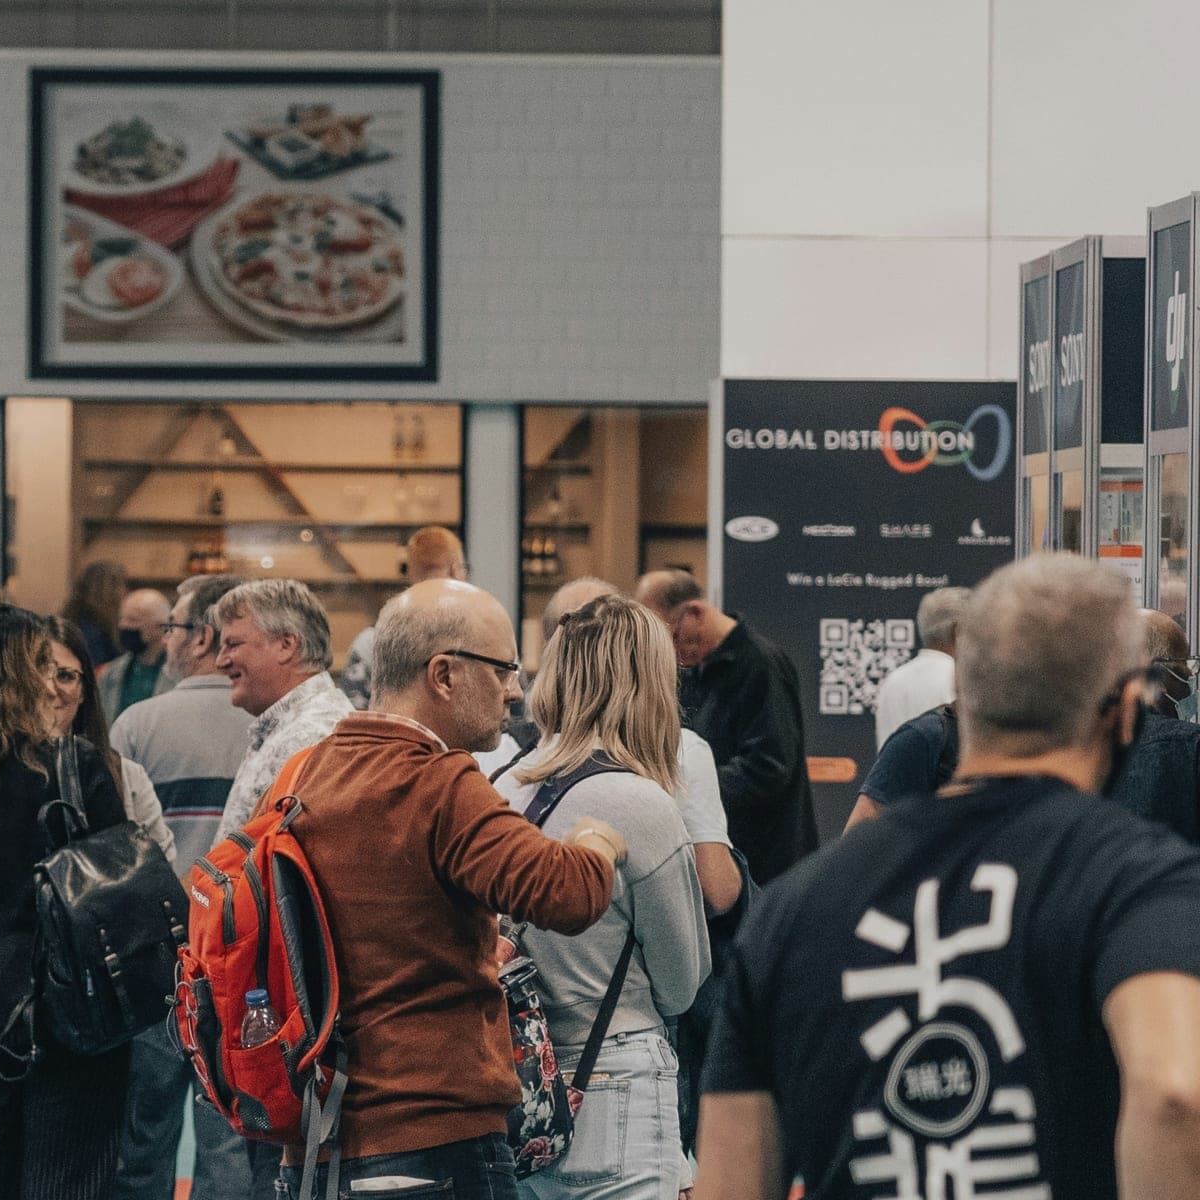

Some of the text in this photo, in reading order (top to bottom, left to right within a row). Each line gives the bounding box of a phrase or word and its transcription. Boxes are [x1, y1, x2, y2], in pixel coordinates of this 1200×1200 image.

[726, 429, 974, 451] GLOBAL DISTRIBUTION
[787, 573, 812, 586] Win
[815, 576, 825, 586] a
[827, 572, 863, 586] LaCie
[865, 572, 913, 590] Rugged
